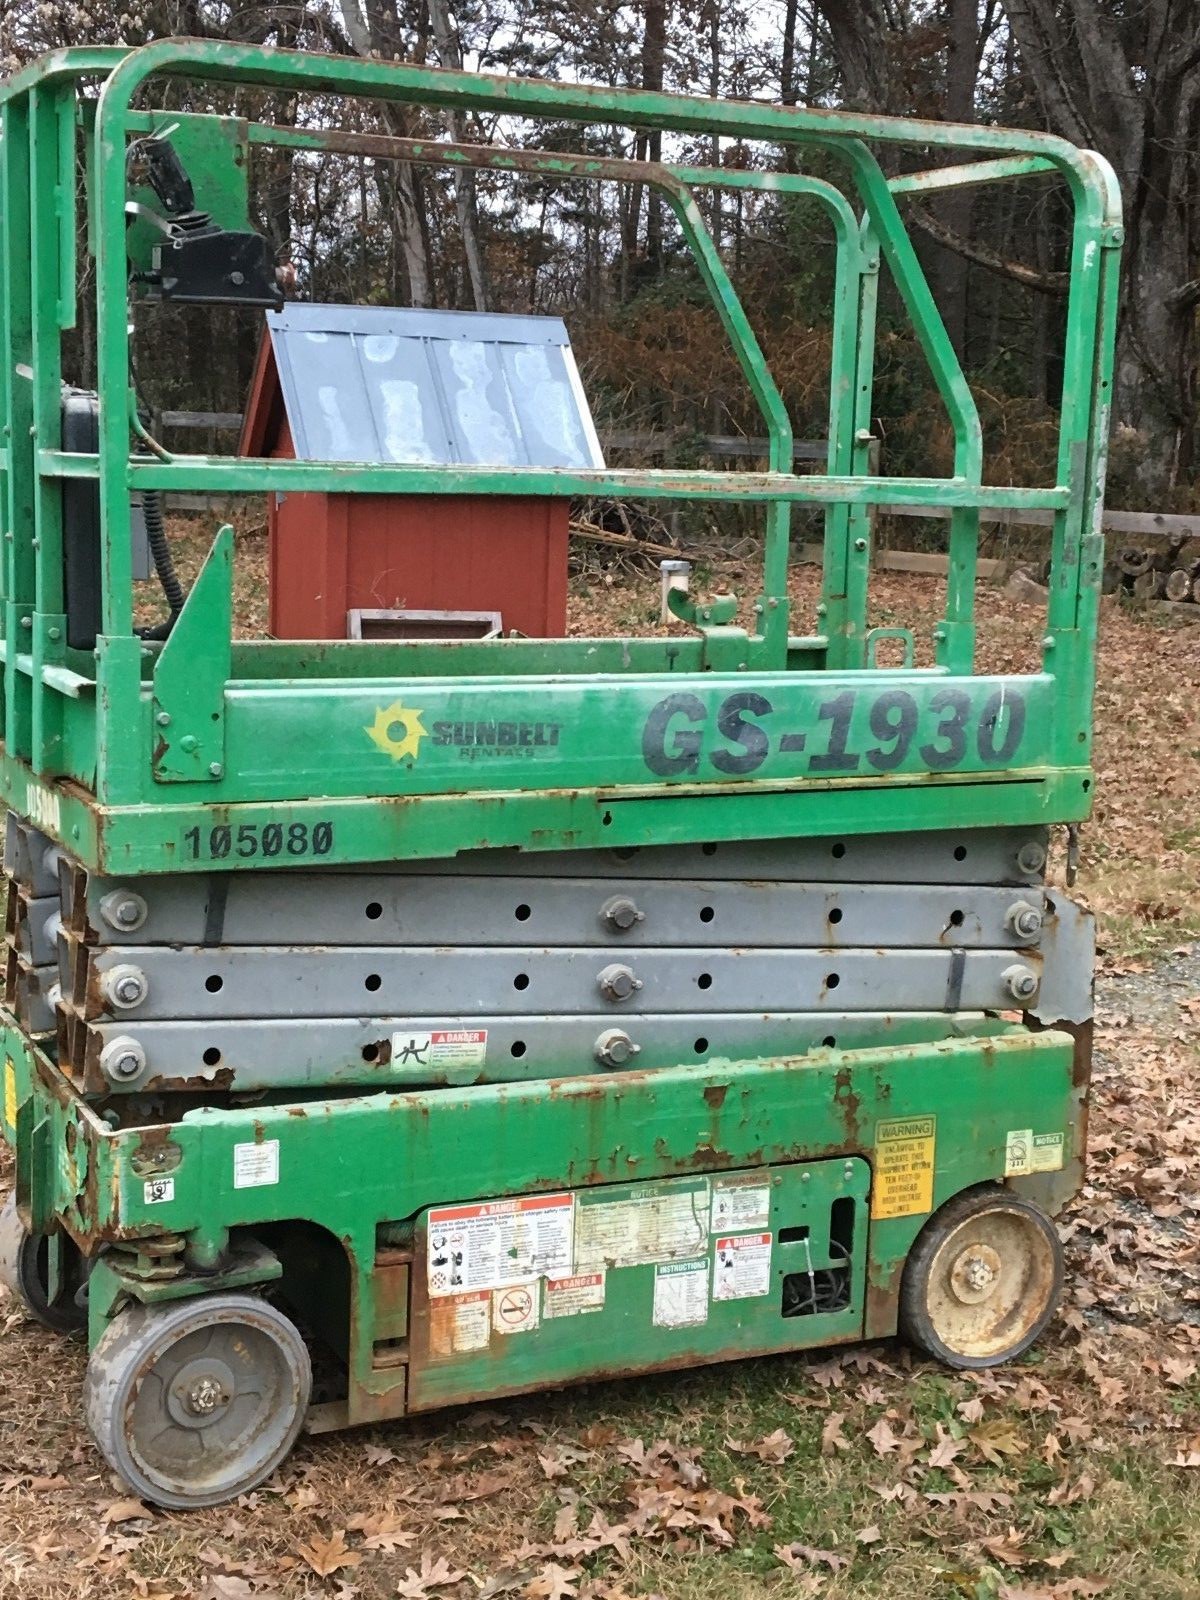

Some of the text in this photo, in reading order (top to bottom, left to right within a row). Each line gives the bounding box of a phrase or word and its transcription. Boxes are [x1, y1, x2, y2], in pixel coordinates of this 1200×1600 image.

[432, 721, 564, 746] SUNBELT
[641, 688, 1027, 776] GS-1930
[460, 747, 535, 759] RENTALS
[184, 821, 334, 859] 105080
[446, 1032, 480, 1042] DANGER
[882, 1123, 930, 1138] WARNING
[1036, 1136, 1060, 1146] NOTICE
[885, 1175, 897, 1184] TEN
[630, 1189, 659, 1199] NOTICE
[733, 1235, 763, 1248] DANGER
[660, 1260, 706, 1274] INSTRUCTIONS
[562, 1276, 597, 1288] DANGER
